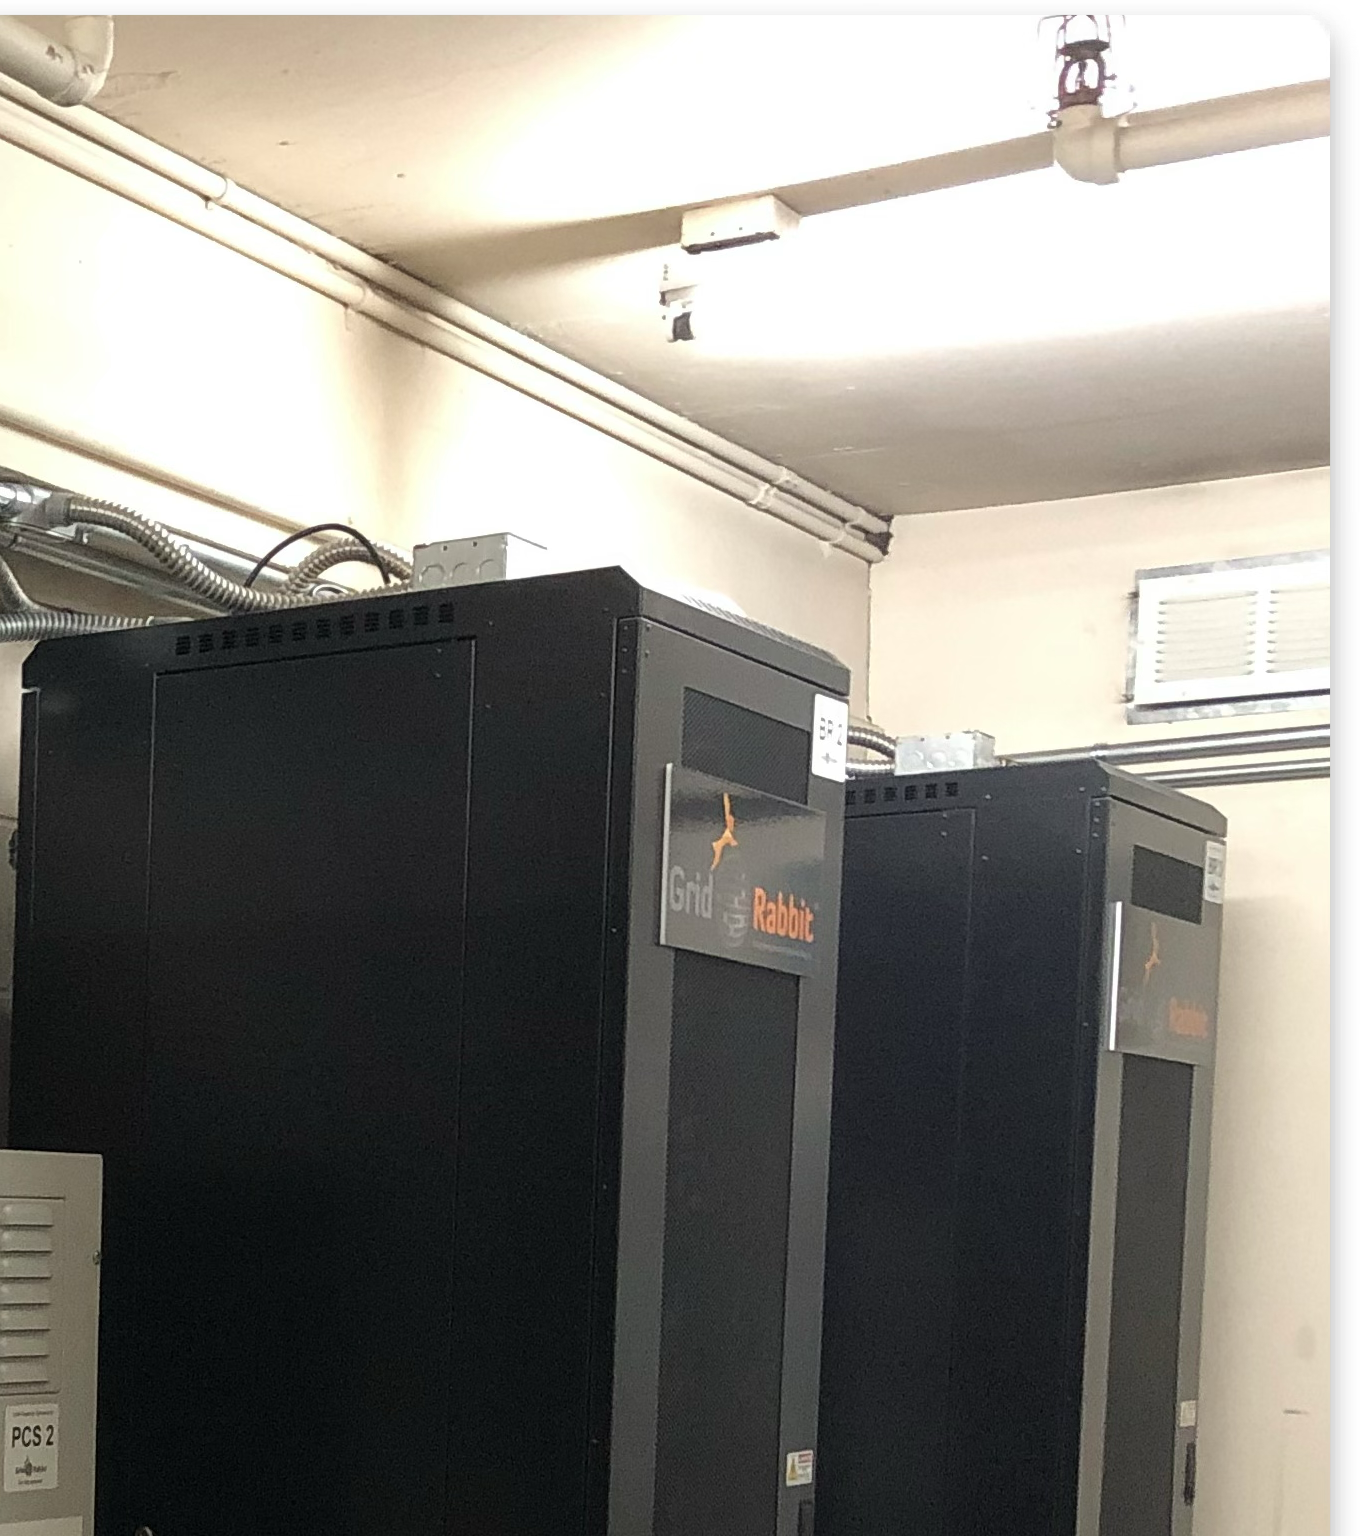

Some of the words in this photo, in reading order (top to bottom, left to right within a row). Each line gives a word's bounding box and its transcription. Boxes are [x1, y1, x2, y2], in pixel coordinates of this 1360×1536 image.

[669, 865, 714, 919] Grid
[753, 886, 815, 943] Rabbit
[11, 1425, 42, 1448] PCS
[45, 1424, 55, 1446] 2
